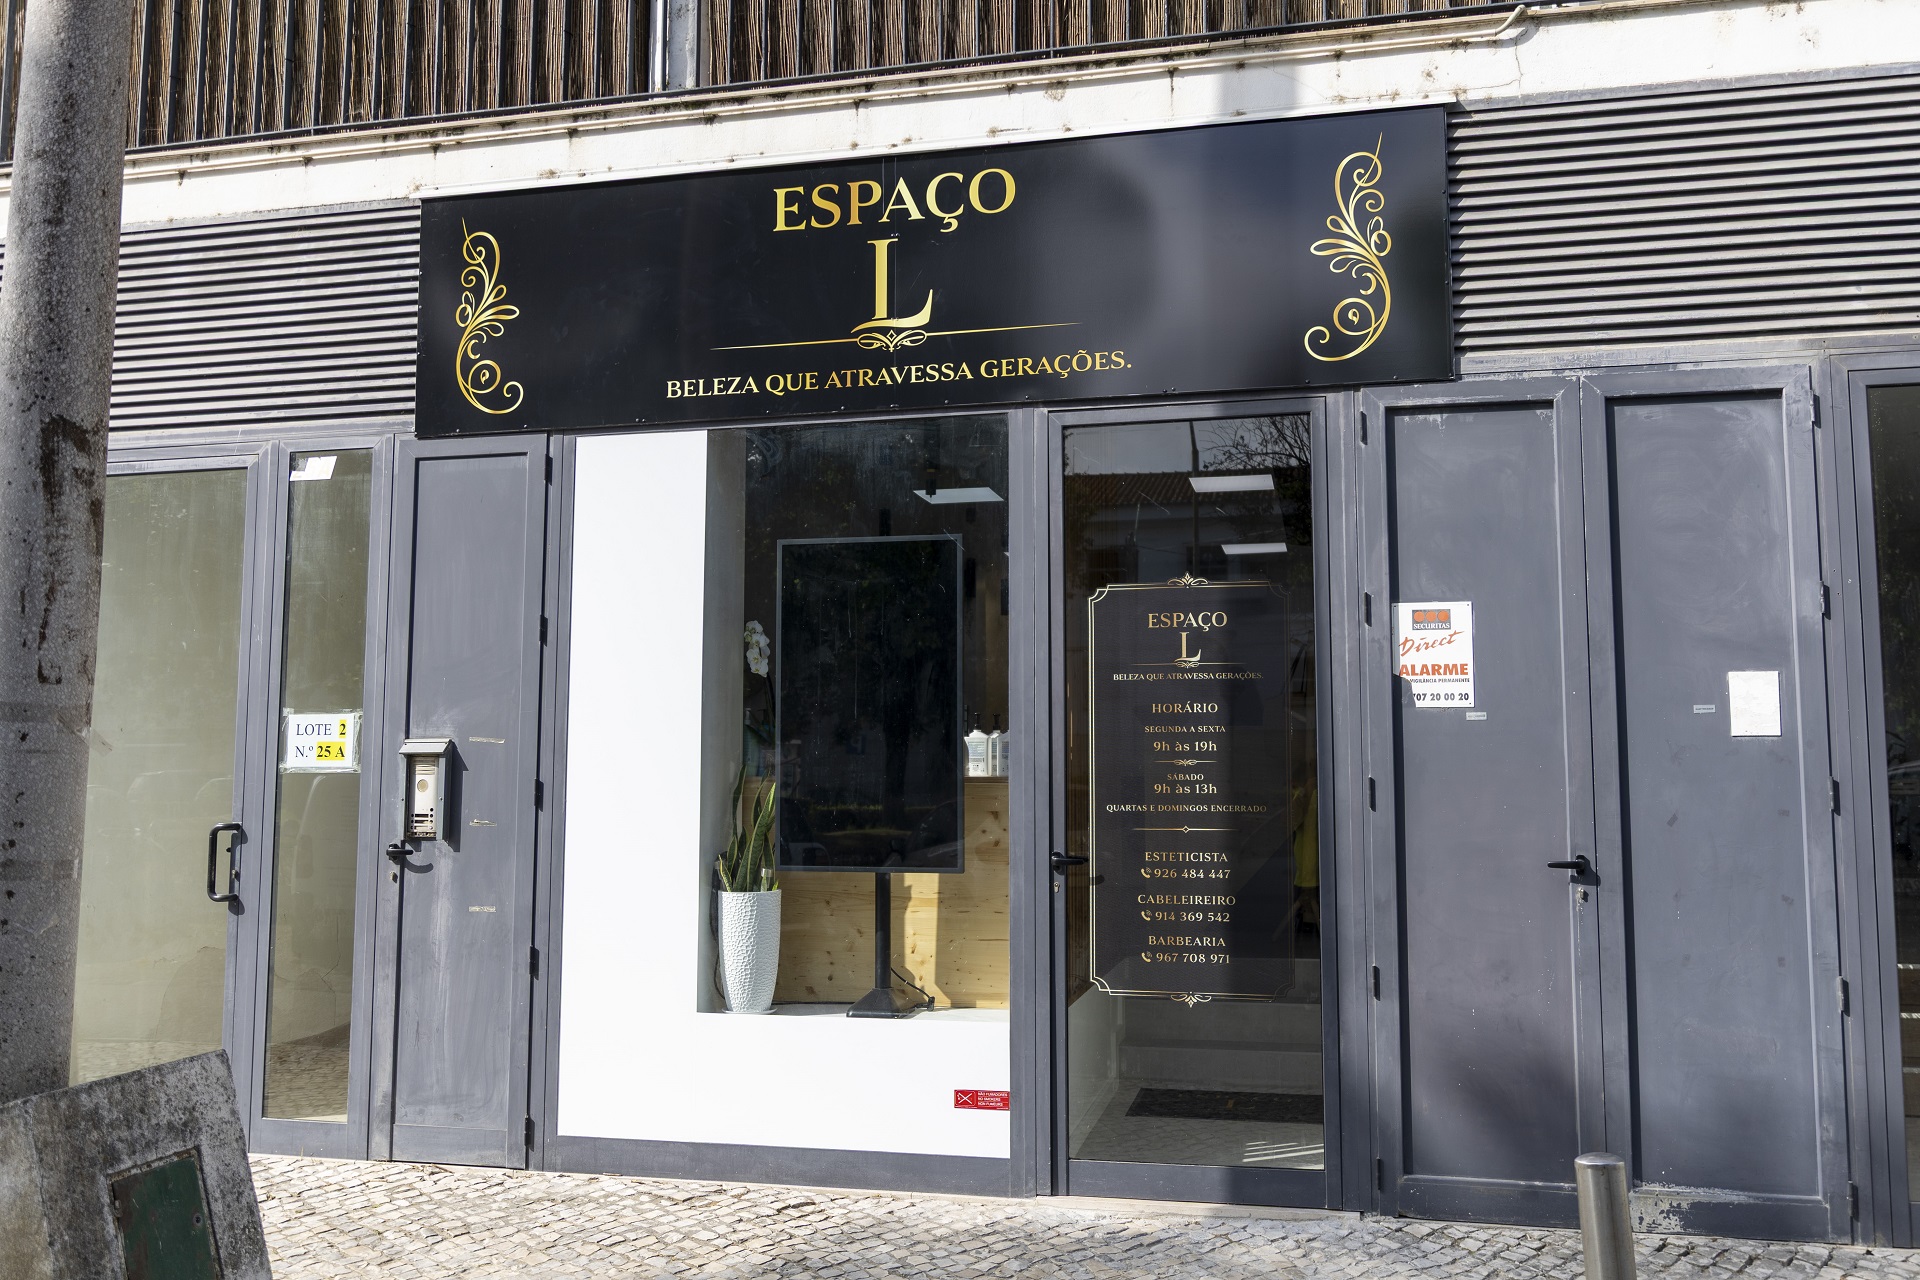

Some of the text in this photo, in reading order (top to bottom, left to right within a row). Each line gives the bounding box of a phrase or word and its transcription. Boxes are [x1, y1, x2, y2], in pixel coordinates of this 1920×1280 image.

[773, 168, 1016, 233] ESPAÇO
[851, 238, 932, 333] L
[666, 350, 1132, 399] BELEZA QUE ATRAVESSA GERAÇÕES.
[1148, 612, 1227, 631] ESPAÇO
[1174, 632, 1201, 662] L
[1399, 630, 1464, 656] Direct
[1399, 663, 1468, 676] ALARME
[1113, 673, 1144, 681] BELEZA
[1147, 673, 1164, 681] QUE
[1216, 672, 1263, 680] GERAÇÕES.
[1430, 693, 1441, 701] 20
[1444, 693, 1455, 701] 00
[1152, 701, 1218, 713] HORÁRIO
[296, 724, 346, 735] LOTE 2
[317, 746, 331, 757] 25
[335, 746, 345, 757] A
[1153, 742, 1217, 751] 9h às 19h
[1154, 784, 1217, 794] 9h às 13h
[1106, 804, 1147, 812] QUARTAS
[1145, 852, 1228, 862] ESTETICISTA
[1154, 869, 1230, 879] 926 484 447
[1138, 895, 1236, 905] CABELEIREIRO
[1155, 912, 1230, 922] 914 369 542
[1149, 936, 1226, 946] BARBEARIA
[1156, 953, 1230, 963] 967 708 971
